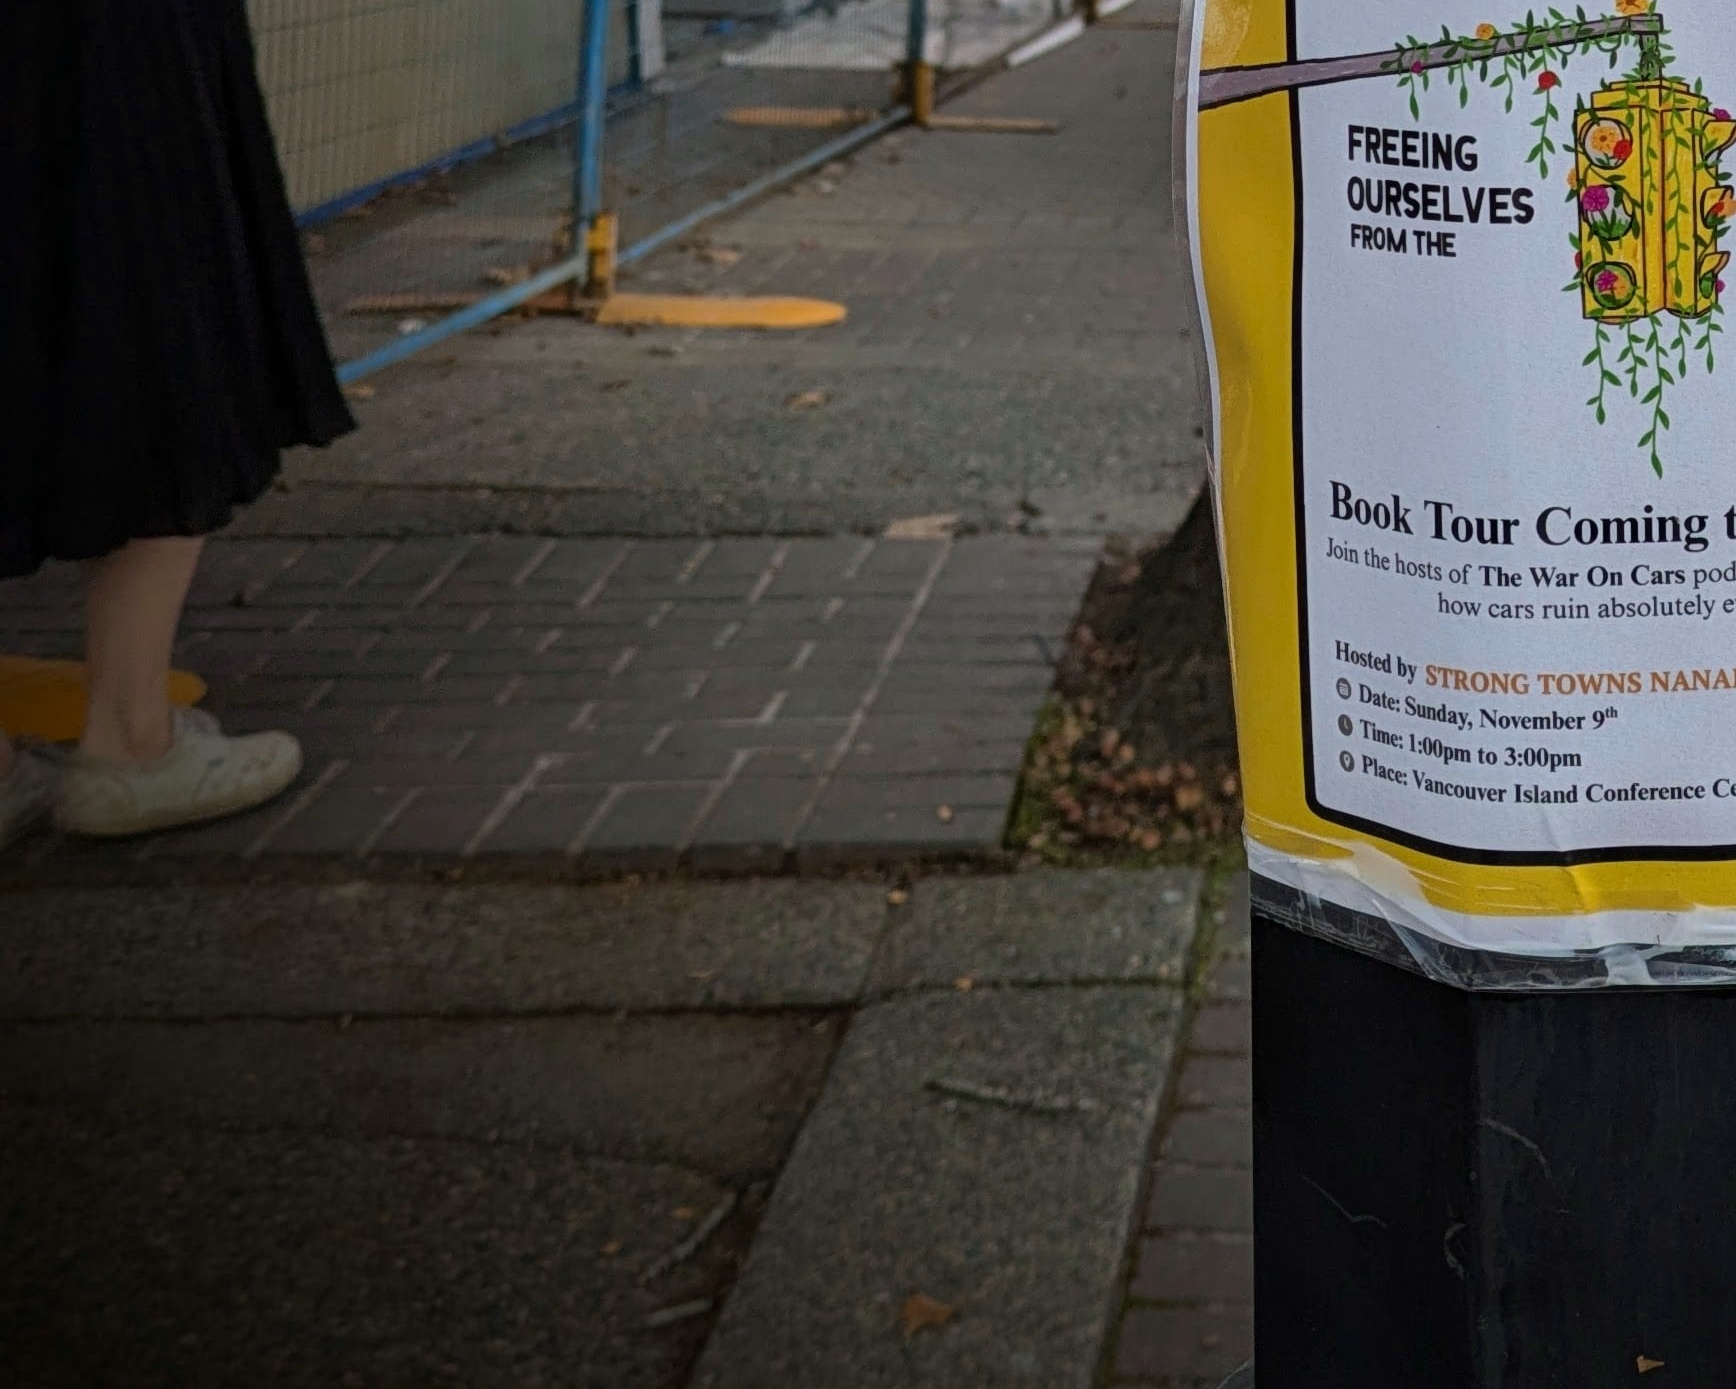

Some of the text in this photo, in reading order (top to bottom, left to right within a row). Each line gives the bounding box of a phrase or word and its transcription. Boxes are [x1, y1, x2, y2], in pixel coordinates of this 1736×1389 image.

[1347, 123, 1478, 172] FREEING
[1347, 175, 1535, 225] OURSELVES
[1350, 223, 1457, 257] FROM THE
[1329, 480, 1414, 535] Book
[1424, 500, 1520, 545] Tour
[1536, 505, 1709, 553] Coming
[1326, 537, 1359, 564] Join
[1364, 547, 1390, 571] the
[1395, 553, 1443, 581] hosts
[1449, 564, 1472, 585] of
[1479, 565, 1523, 587] The
[1530, 566, 1579, 588] War
[1587, 565, 1623, 587] On
[1630, 564, 1686, 586] Cars
[1438, 591, 1481, 616] how
[1488, 600, 1535, 619] cars
[1542, 597, 1590, 619] ruin
[1597, 593, 1715, 621] absolutely
[1334, 639, 1392, 674] Hosted
[1396, 656, 1417, 684] by
[1425, 663, 1530, 695] STRONG
[1537, 672, 1642, 695] TOWNS
[1358, 683, 1619, 732] Date: Sunday, November 9th
[1360, 718, 1582, 773] Time: 1:00pm to 3:00pm
[1361, 754, 1408, 786] Place:
[1412, 769, 1507, 803] Vancouver
[1513, 783, 1578, 804] Island
[1585, 782, 1706, 803] Conference
